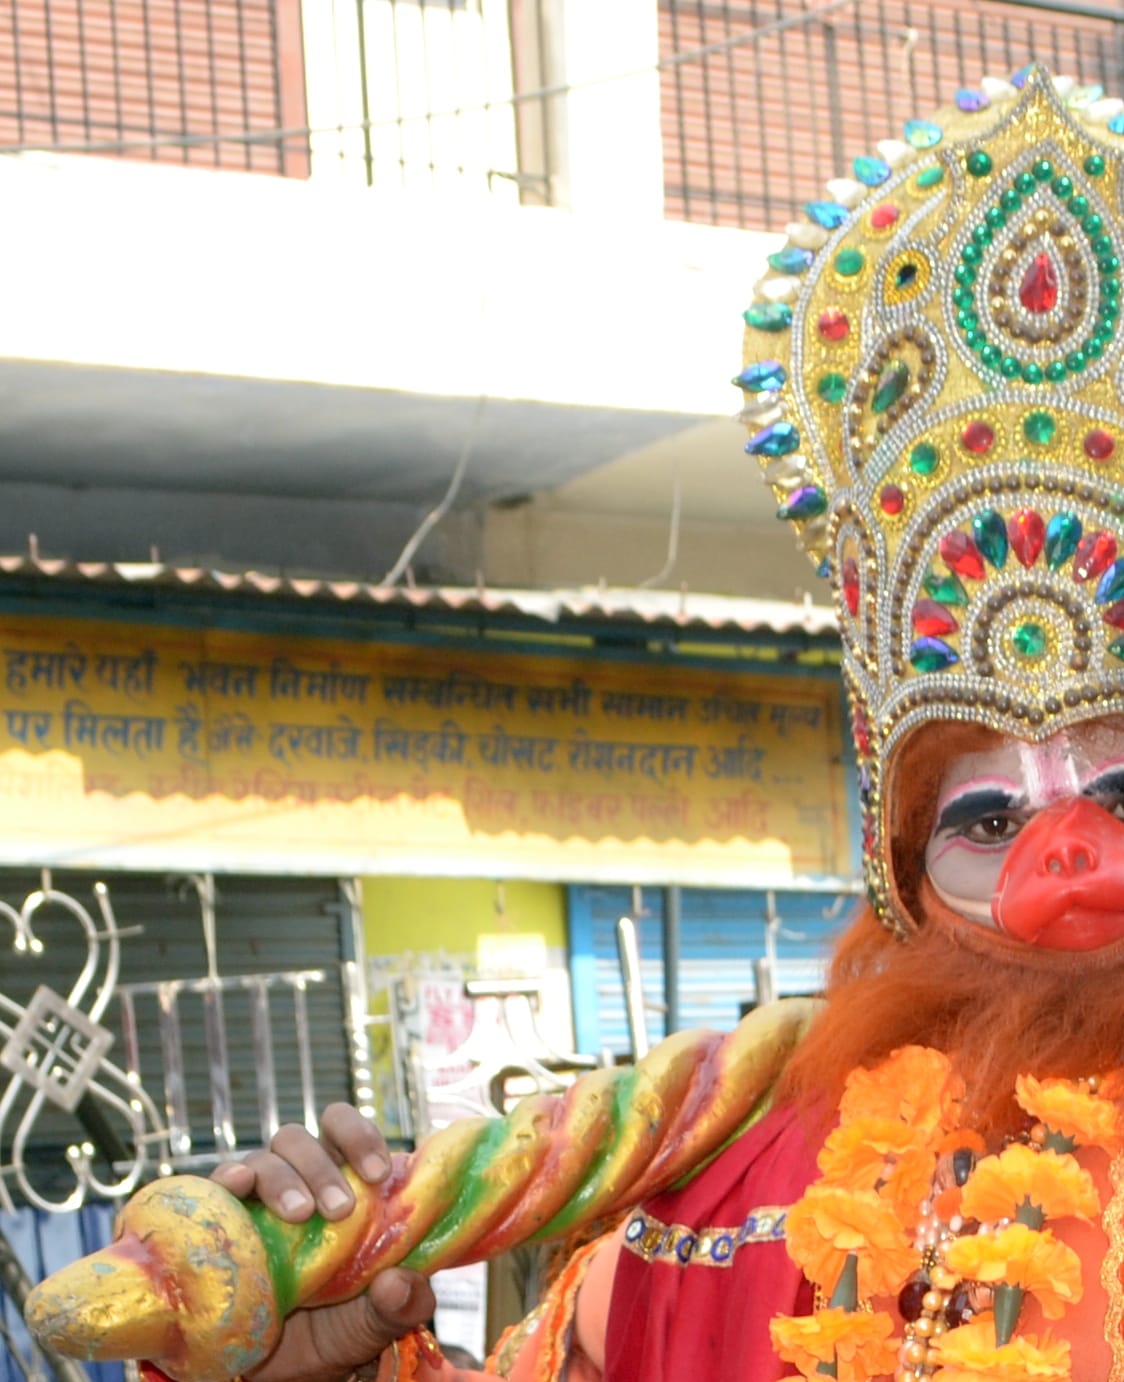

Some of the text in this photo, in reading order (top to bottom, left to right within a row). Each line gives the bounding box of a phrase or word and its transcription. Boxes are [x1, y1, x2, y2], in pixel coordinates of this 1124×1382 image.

[4, 642, 88, 697] हमारे
[177, 658, 260, 698] भवन
[268, 656, 371, 704] निर्माण
[525, 677, 593, 718] सभी
[601, 690, 691, 725] सामान
[4, 709, 53, 753] पर
[63, 698, 168, 763] मिलता
